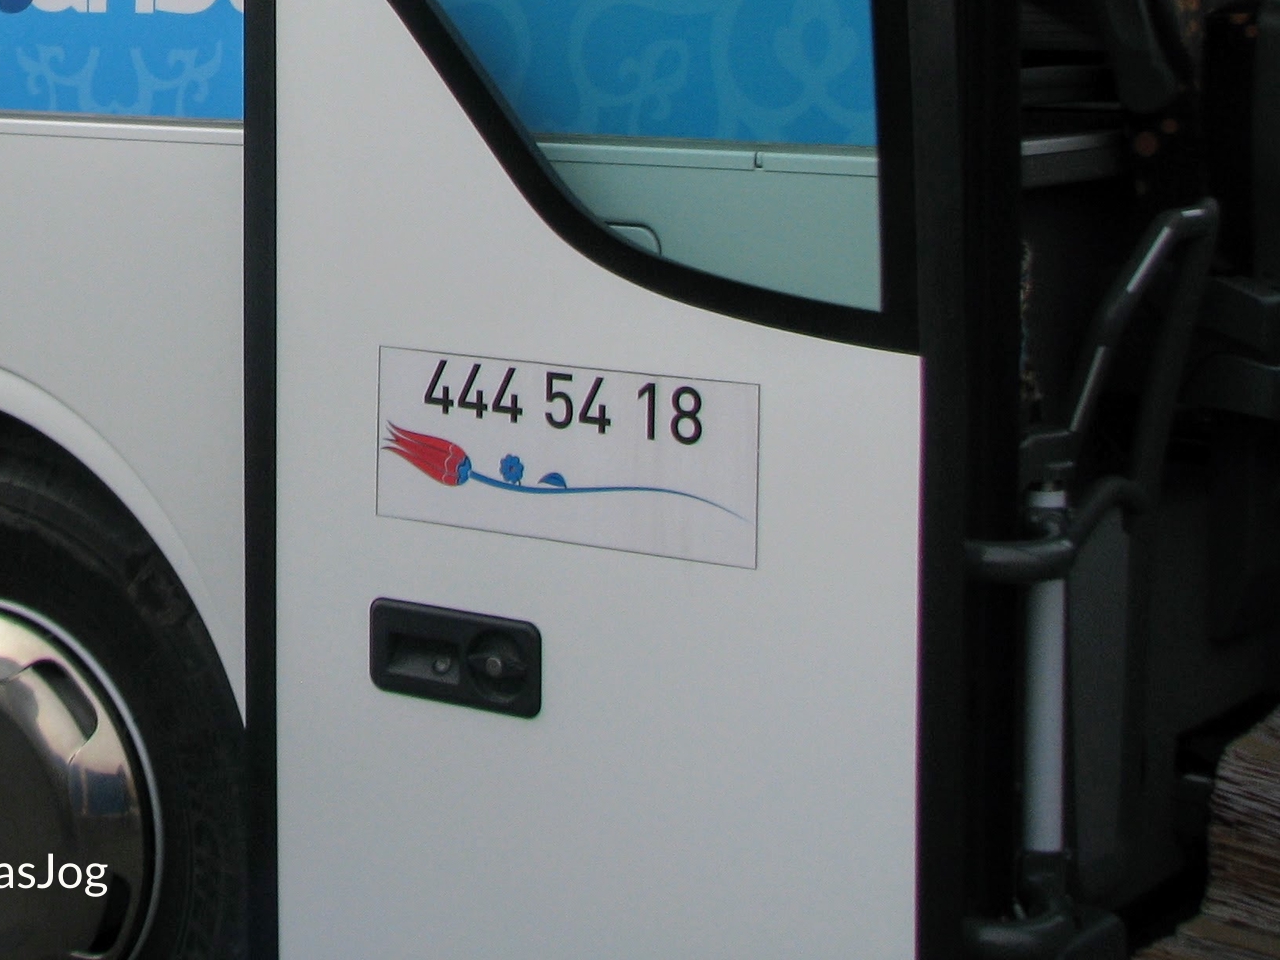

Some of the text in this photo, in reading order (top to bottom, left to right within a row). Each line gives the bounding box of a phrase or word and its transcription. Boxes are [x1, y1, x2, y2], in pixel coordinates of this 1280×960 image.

[423, 359, 703, 445] 444 54 18
